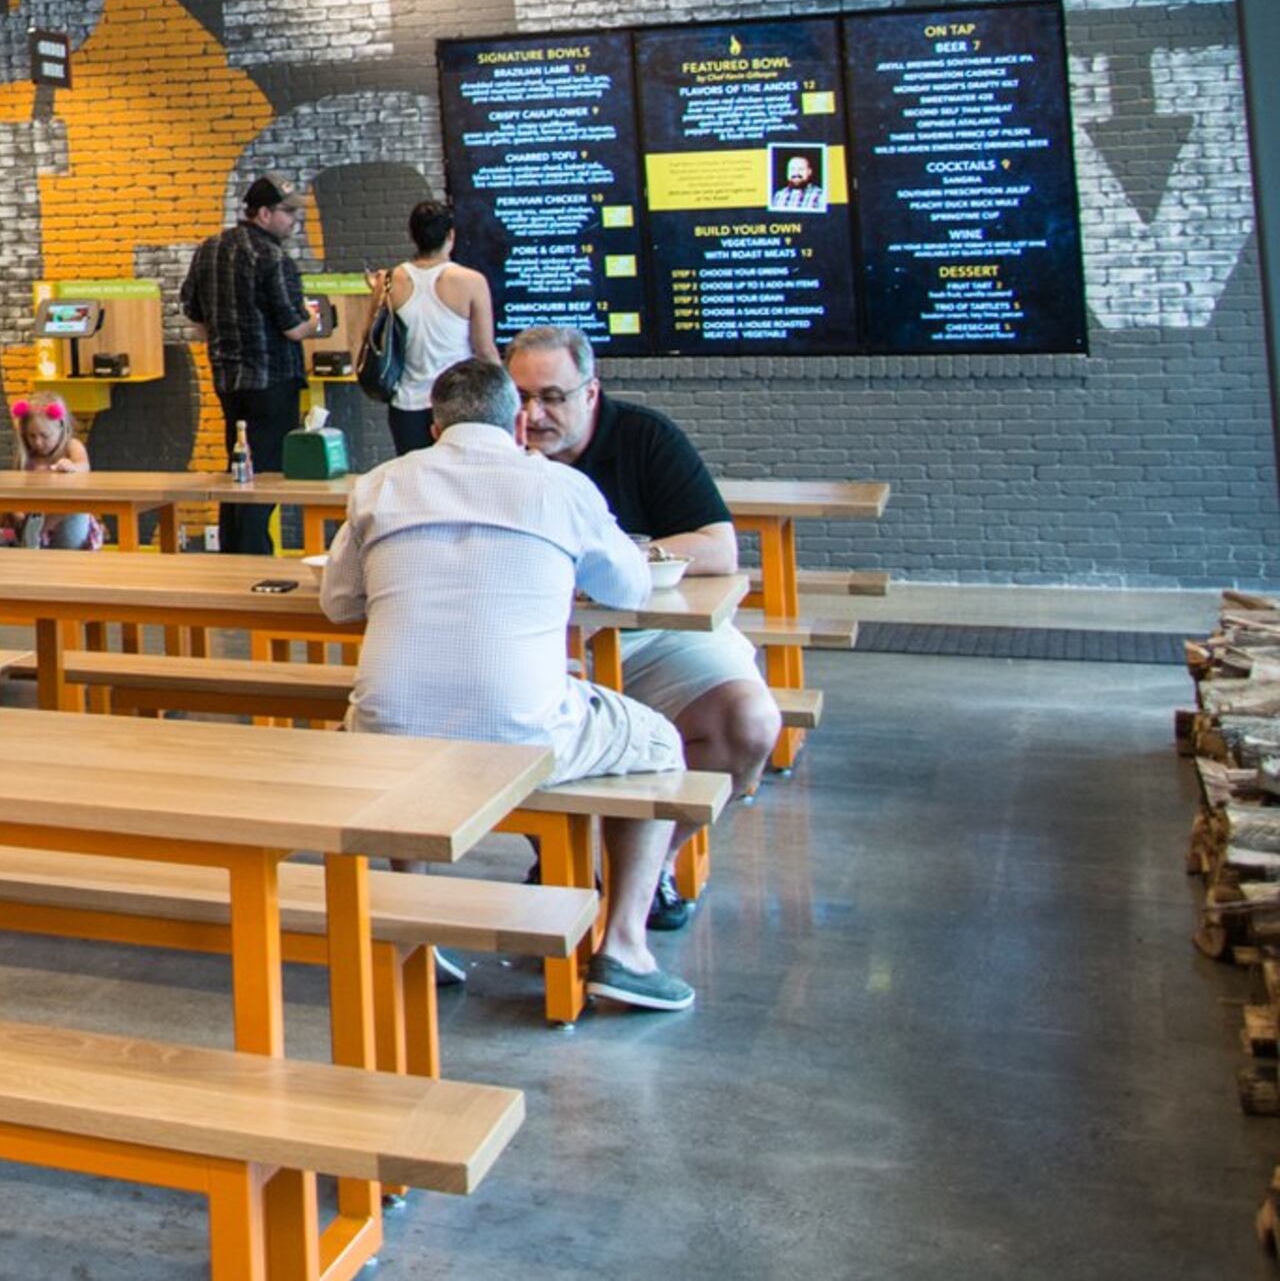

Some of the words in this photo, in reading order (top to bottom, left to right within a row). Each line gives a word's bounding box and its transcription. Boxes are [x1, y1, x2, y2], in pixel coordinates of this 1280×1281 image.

[924, 26, 947, 38] ON
[950, 24, 976, 36] TAP
[935, 41, 967, 53] BEER
[973, 40, 981, 51] 7
[478, 50, 543, 64] SIGNATURE
[547, 46, 591, 60] BOWLS
[682, 60, 749, 73] FEATURED
[752, 57, 792, 69] BOWL
[946, 57, 992, 67] SOUTHERN
[494, 66, 542, 78] BRAZILIAN
[544, 65, 570, 74] LAMB
[903, 71, 964, 81] REFORMATION
[965, 68, 1006, 78] CADENCE
[679, 85, 723, 96] FLAVORS
[725, 84, 740, 94] OF
[742, 83, 761, 93] THE
[763, 81, 798, 92] ANDES
[893, 85, 930, 94] MONDAY
[920, 94, 976, 105] SWEETWATER
[489, 109, 520, 121] CRISPY
[522, 107, 588, 119] CAULIFLOWER
[903, 108, 939, 117] SECOND
[940, 107, 960, 115] SELF
[982, 104, 1013, 113] WHEAT
[987, 129, 1000, 137] OF
[874, 145, 895, 154] WILD
[897, 144, 930, 153] HEAVEN
[932, 141, 983, 151] EMERGENCY
[984, 140, 1025, 150] DRINKING
[1027, 139, 1049, 147] BEER
[505, 152, 549, 163] CHARRED
[552, 151, 577, 160] TOFU
[926, 160, 996, 173] COCKTAILS
[1001, 159, 1010, 170] 9
[942, 176, 983, 184] SANGRIA
[897, 189, 943, 199] SOUTHERN
[944, 187, 1003, 197] PRESCRIPTION
[496, 196, 543, 206] PERUVIAN
[544, 194, 587, 204] CHICKEN
[591, 193, 604, 203] 10
[995, 199, 1019, 207] MULE
[930, 212, 980, 222] SPRINGTIME
[982, 211, 1000, 219] CUP
[694, 225, 730, 236] BUILD
[732, 224, 767, 235] YOUR
[769, 223, 801, 234] OWN
[948, 229, 984, 240] WINE
[721, 237, 781, 248] VEGETARIAN
[512, 246, 538, 256] PORK
[540, 245, 547, 254] &
[549, 245, 576, 254] GRITS
[581, 244, 593, 253] 10
[704, 251, 729, 260] WITH
[731, 249, 762, 259] ROAST
[764, 248, 796, 258] MEATS
[699, 269, 733, 277] CHOOSE
[734, 268, 756, 276] YOUR
[938, 265, 999, 278] DESSERT
[700, 282, 734, 290] CHOOSE
[796, 279, 820, 288] ITEMS
[946, 282, 970, 290] FRUIT
[701, 295, 735, 304] CHOOSE
[736, 294, 757, 302] YOUR
[504, 302, 566, 312] CHIMICHURRI
[568, 302, 592, 311] BEEF
[701, 308, 736, 316] CHOOSE
[744, 307, 769, 316] SAUCE
[771, 307, 783, 315] OR
[784, 306, 824, 315] DRESSING
[935, 303, 955, 311] TRIO
[970, 302, 1010, 310] TARTLETS
[703, 321, 736, 329] CHOOSE
[744, 320, 772, 329] HOUSE
[773, 320, 811, 328] ROASTED
[945, 323, 1000, 331] CHEESECAKE
[703, 331, 725, 339] MEAT
[742, 330, 787, 338] VEGETABLE
